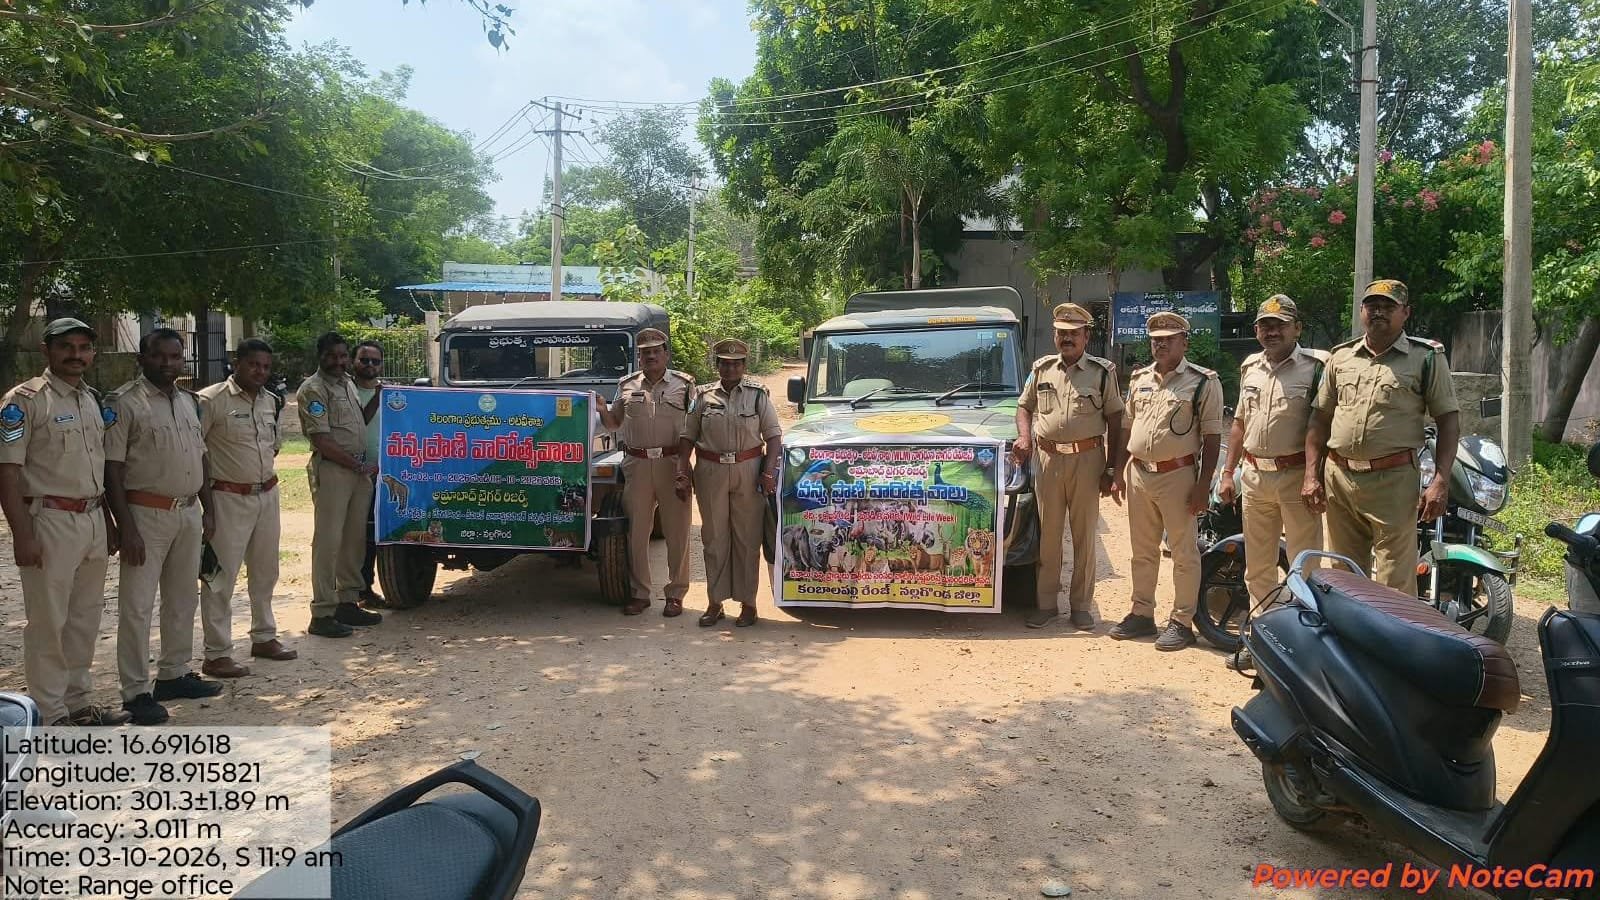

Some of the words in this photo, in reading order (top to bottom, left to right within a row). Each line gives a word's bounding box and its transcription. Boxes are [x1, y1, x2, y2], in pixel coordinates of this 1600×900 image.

[489, 336, 527, 349] ప్రభుత్వ
[533, 335, 590, 345] వాహనము
[429, 413, 463, 425] తెలంగాణ
[471, 430, 584, 469] వారోత్సవాలు
[478, 488, 502, 508] టైగర్
[797, 481, 828, 505] వన్య
[869, 480, 967, 506] వారోత్సవాలు
[798, 583, 859, 599] కంబాలపల్లి
[861, 583, 891, 596] రేంజ్
[900, 587, 952, 600] నల్లగొండ
[954, 590, 981, 603] జిల్లా
